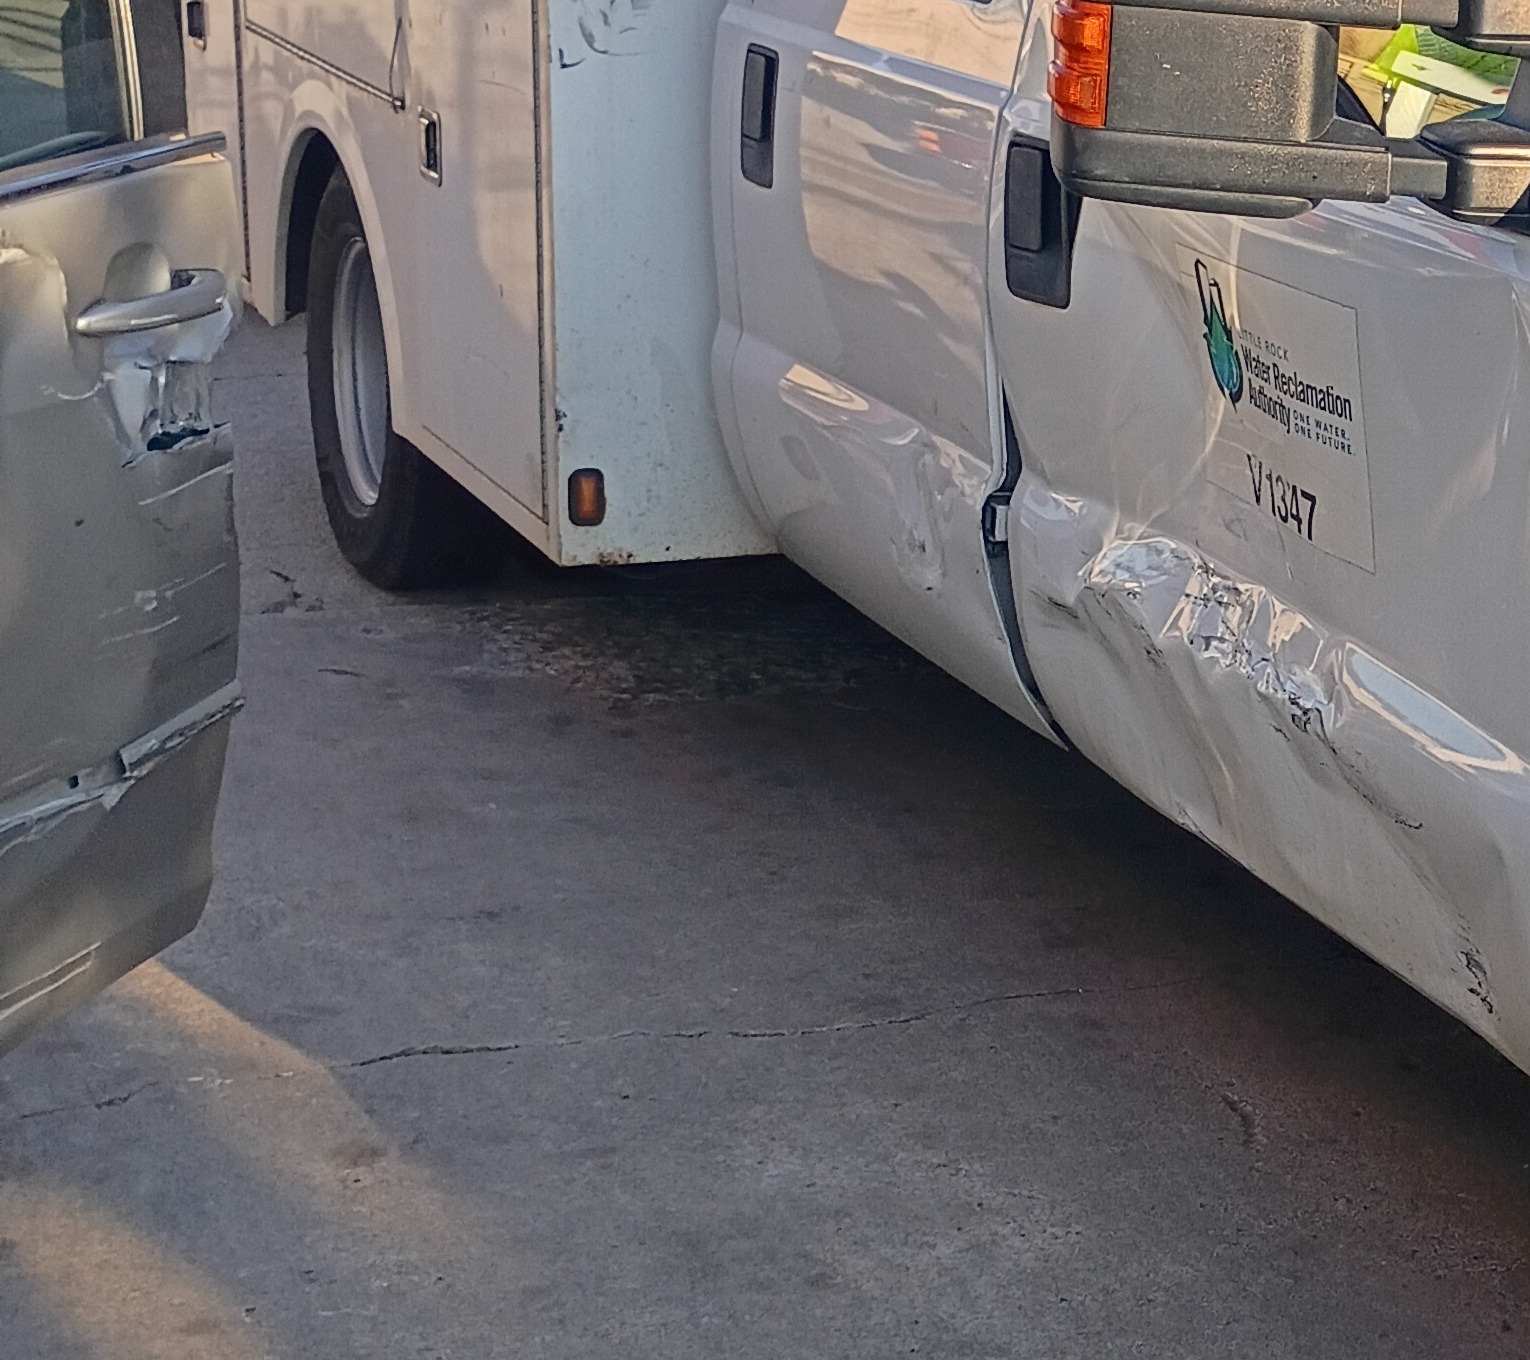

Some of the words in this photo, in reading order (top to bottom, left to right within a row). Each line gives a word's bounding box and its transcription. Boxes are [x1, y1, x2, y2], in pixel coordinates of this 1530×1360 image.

[1264, 340, 1290, 362] ROCK
[1240, 343, 1271, 386] Water
[1272, 362, 1353, 422] Reclamation
[1248, 376, 1291, 435] Authority
[1293, 409, 1311, 426] ONE
[1294, 422, 1313, 439] ONE
